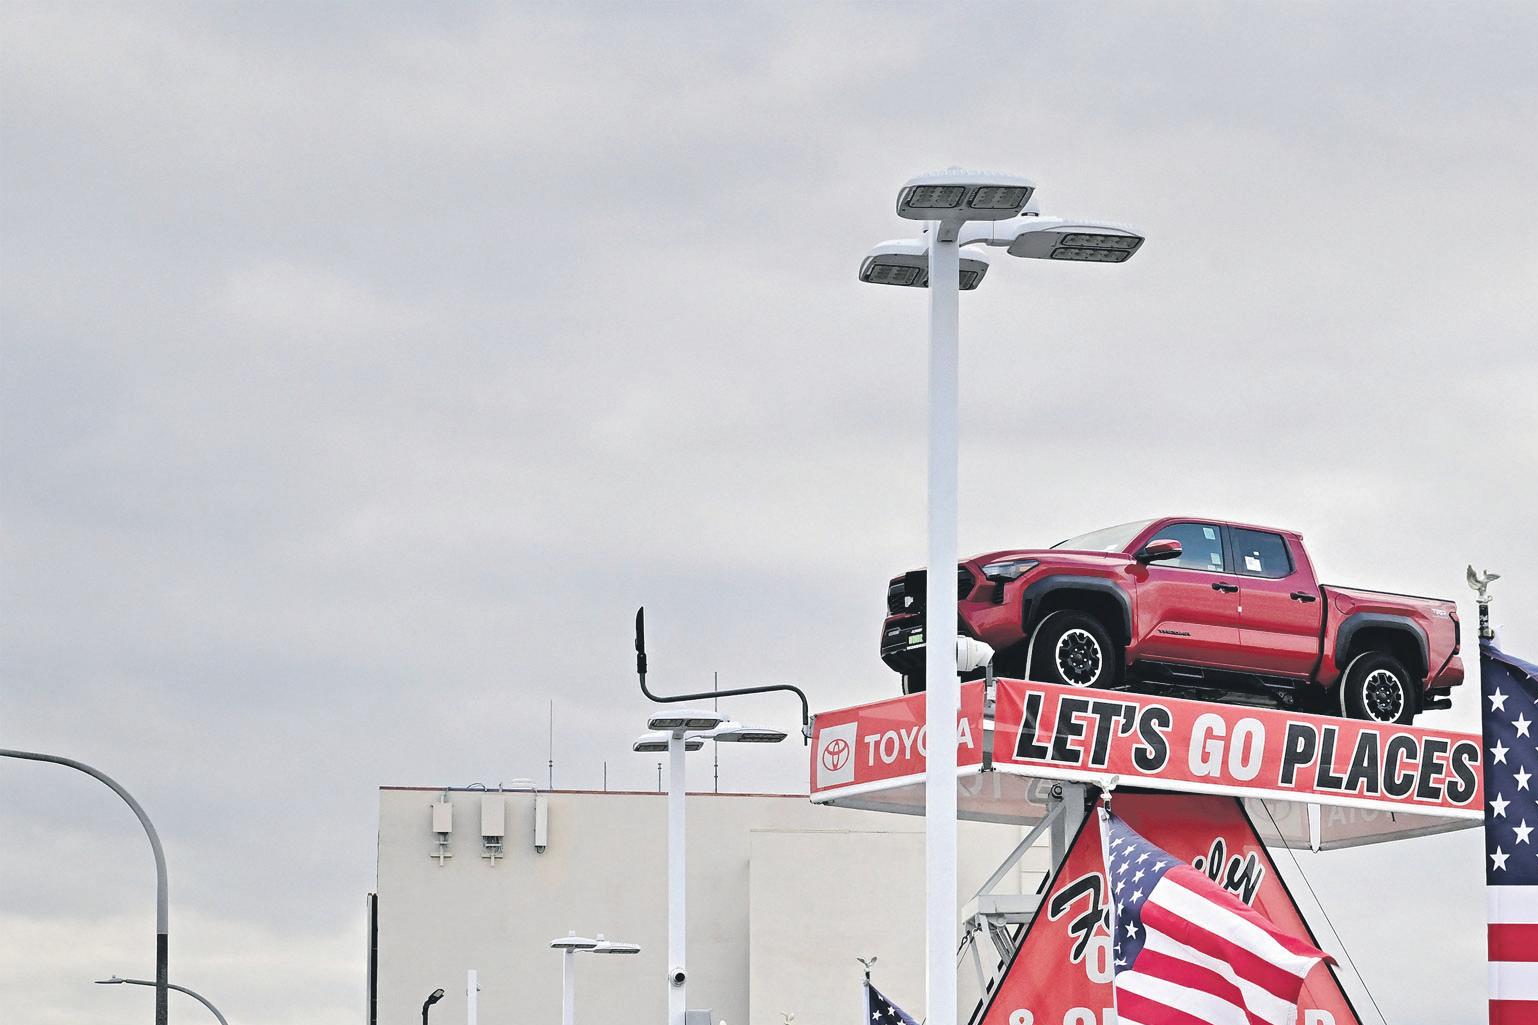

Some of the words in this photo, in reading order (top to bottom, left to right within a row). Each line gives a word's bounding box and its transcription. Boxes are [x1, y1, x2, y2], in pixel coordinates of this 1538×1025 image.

[864, 718, 974, 766] TOYA
[1012, 692, 1173, 775] LET'S
[1188, 713, 1264, 781] GO
[1278, 722, 1480, 805] PLACES
